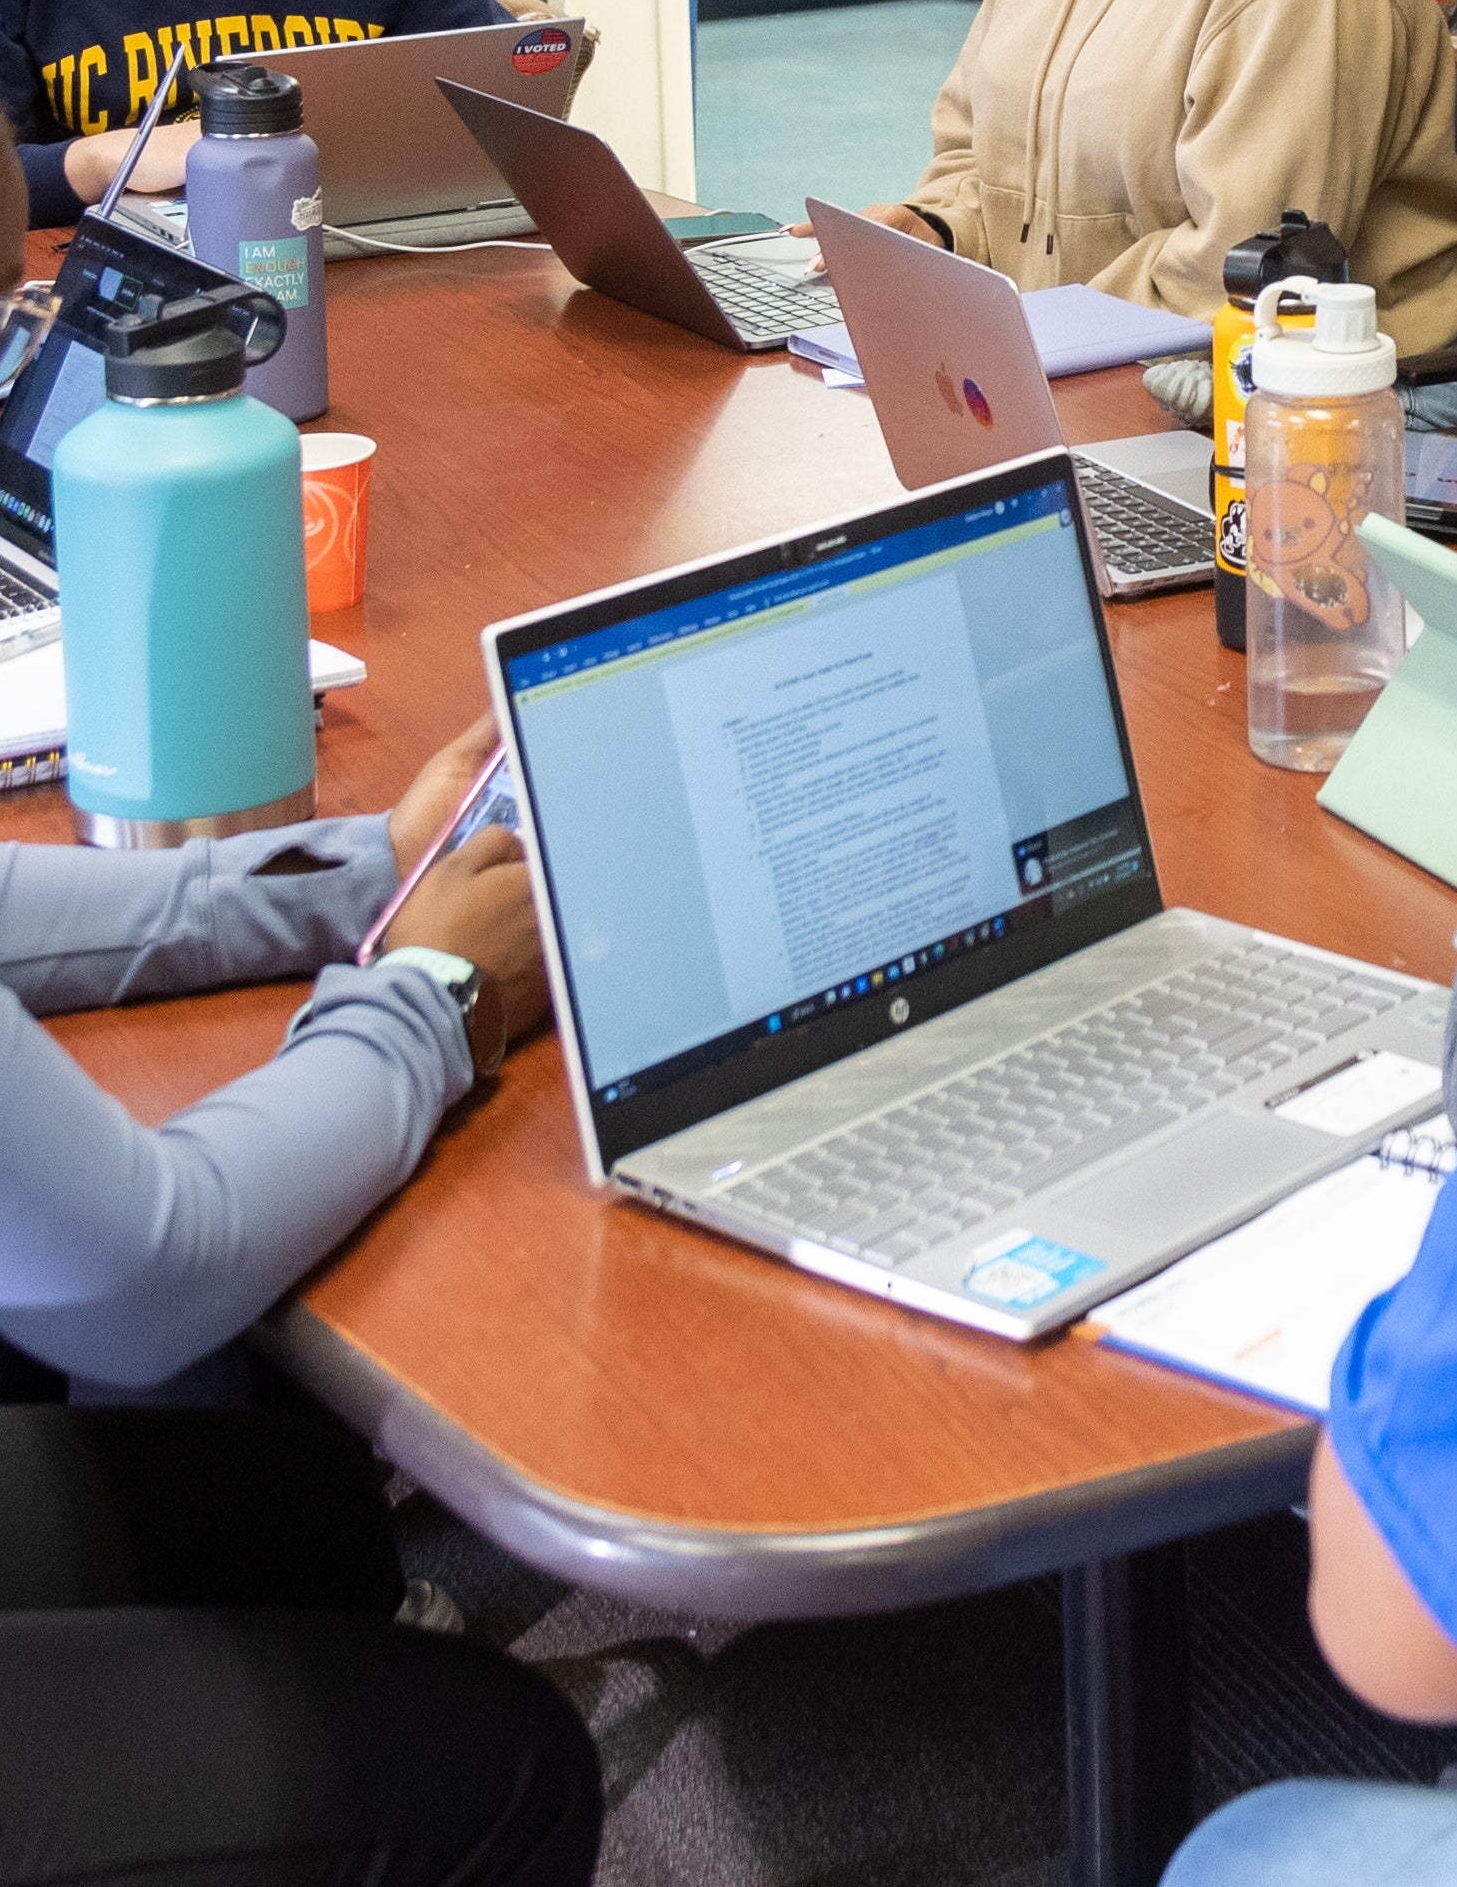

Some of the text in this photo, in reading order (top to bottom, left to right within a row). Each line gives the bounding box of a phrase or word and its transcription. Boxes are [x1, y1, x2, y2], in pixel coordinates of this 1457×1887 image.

[516, 43, 567, 54] I VOTED
[42, 44, 109, 136] UC
[244, 246, 276, 259] I AM
[245, 257, 305, 274] ENOUGH
[244, 272, 305, 289] EXACTLY
